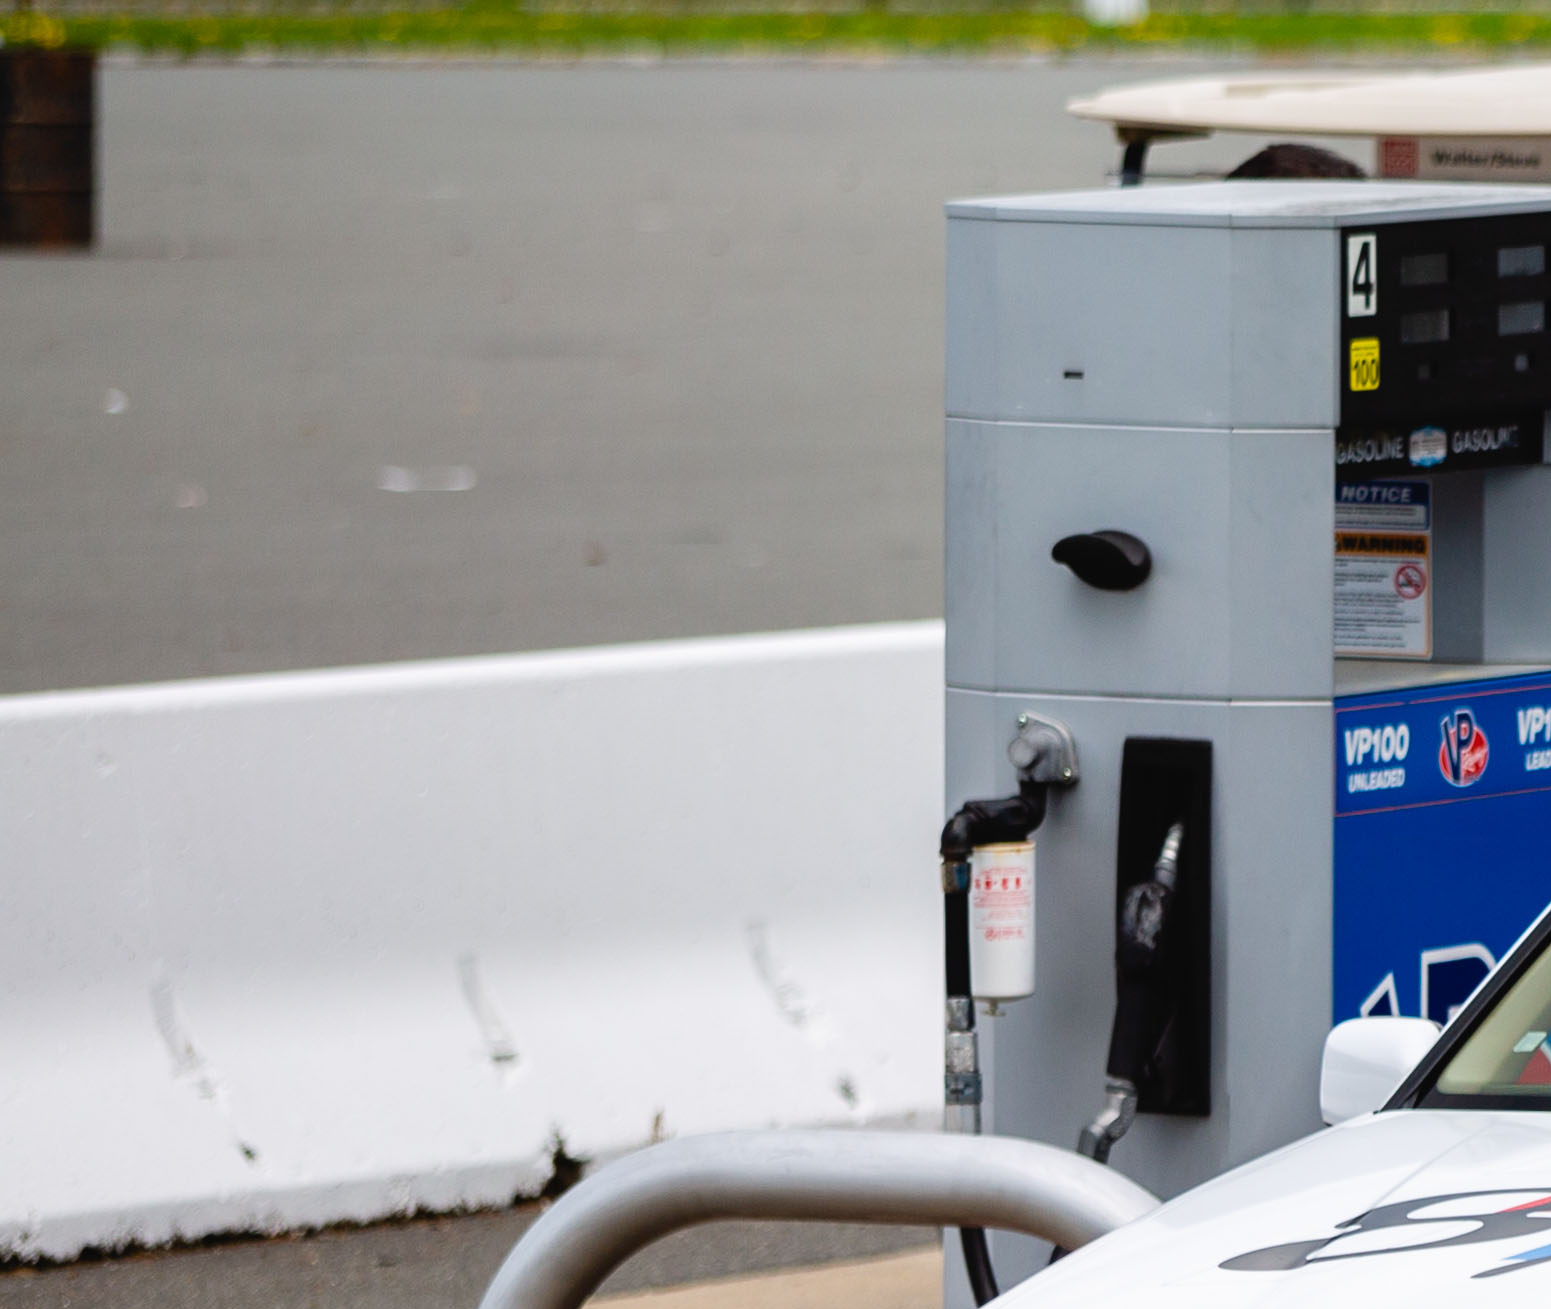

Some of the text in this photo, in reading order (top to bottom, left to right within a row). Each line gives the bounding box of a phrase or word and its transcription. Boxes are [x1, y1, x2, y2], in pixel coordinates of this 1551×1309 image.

[1352, 240, 1374, 311] 4
[1354, 359, 1380, 387] 100
[1337, 436, 1405, 465] GASOLINE
[1341, 485, 1412, 503] NOTICE
[1343, 535, 1425, 554] WARNING
[1344, 724, 1410, 766] VP100
[1347, 768, 1406, 794] UNLEADED
